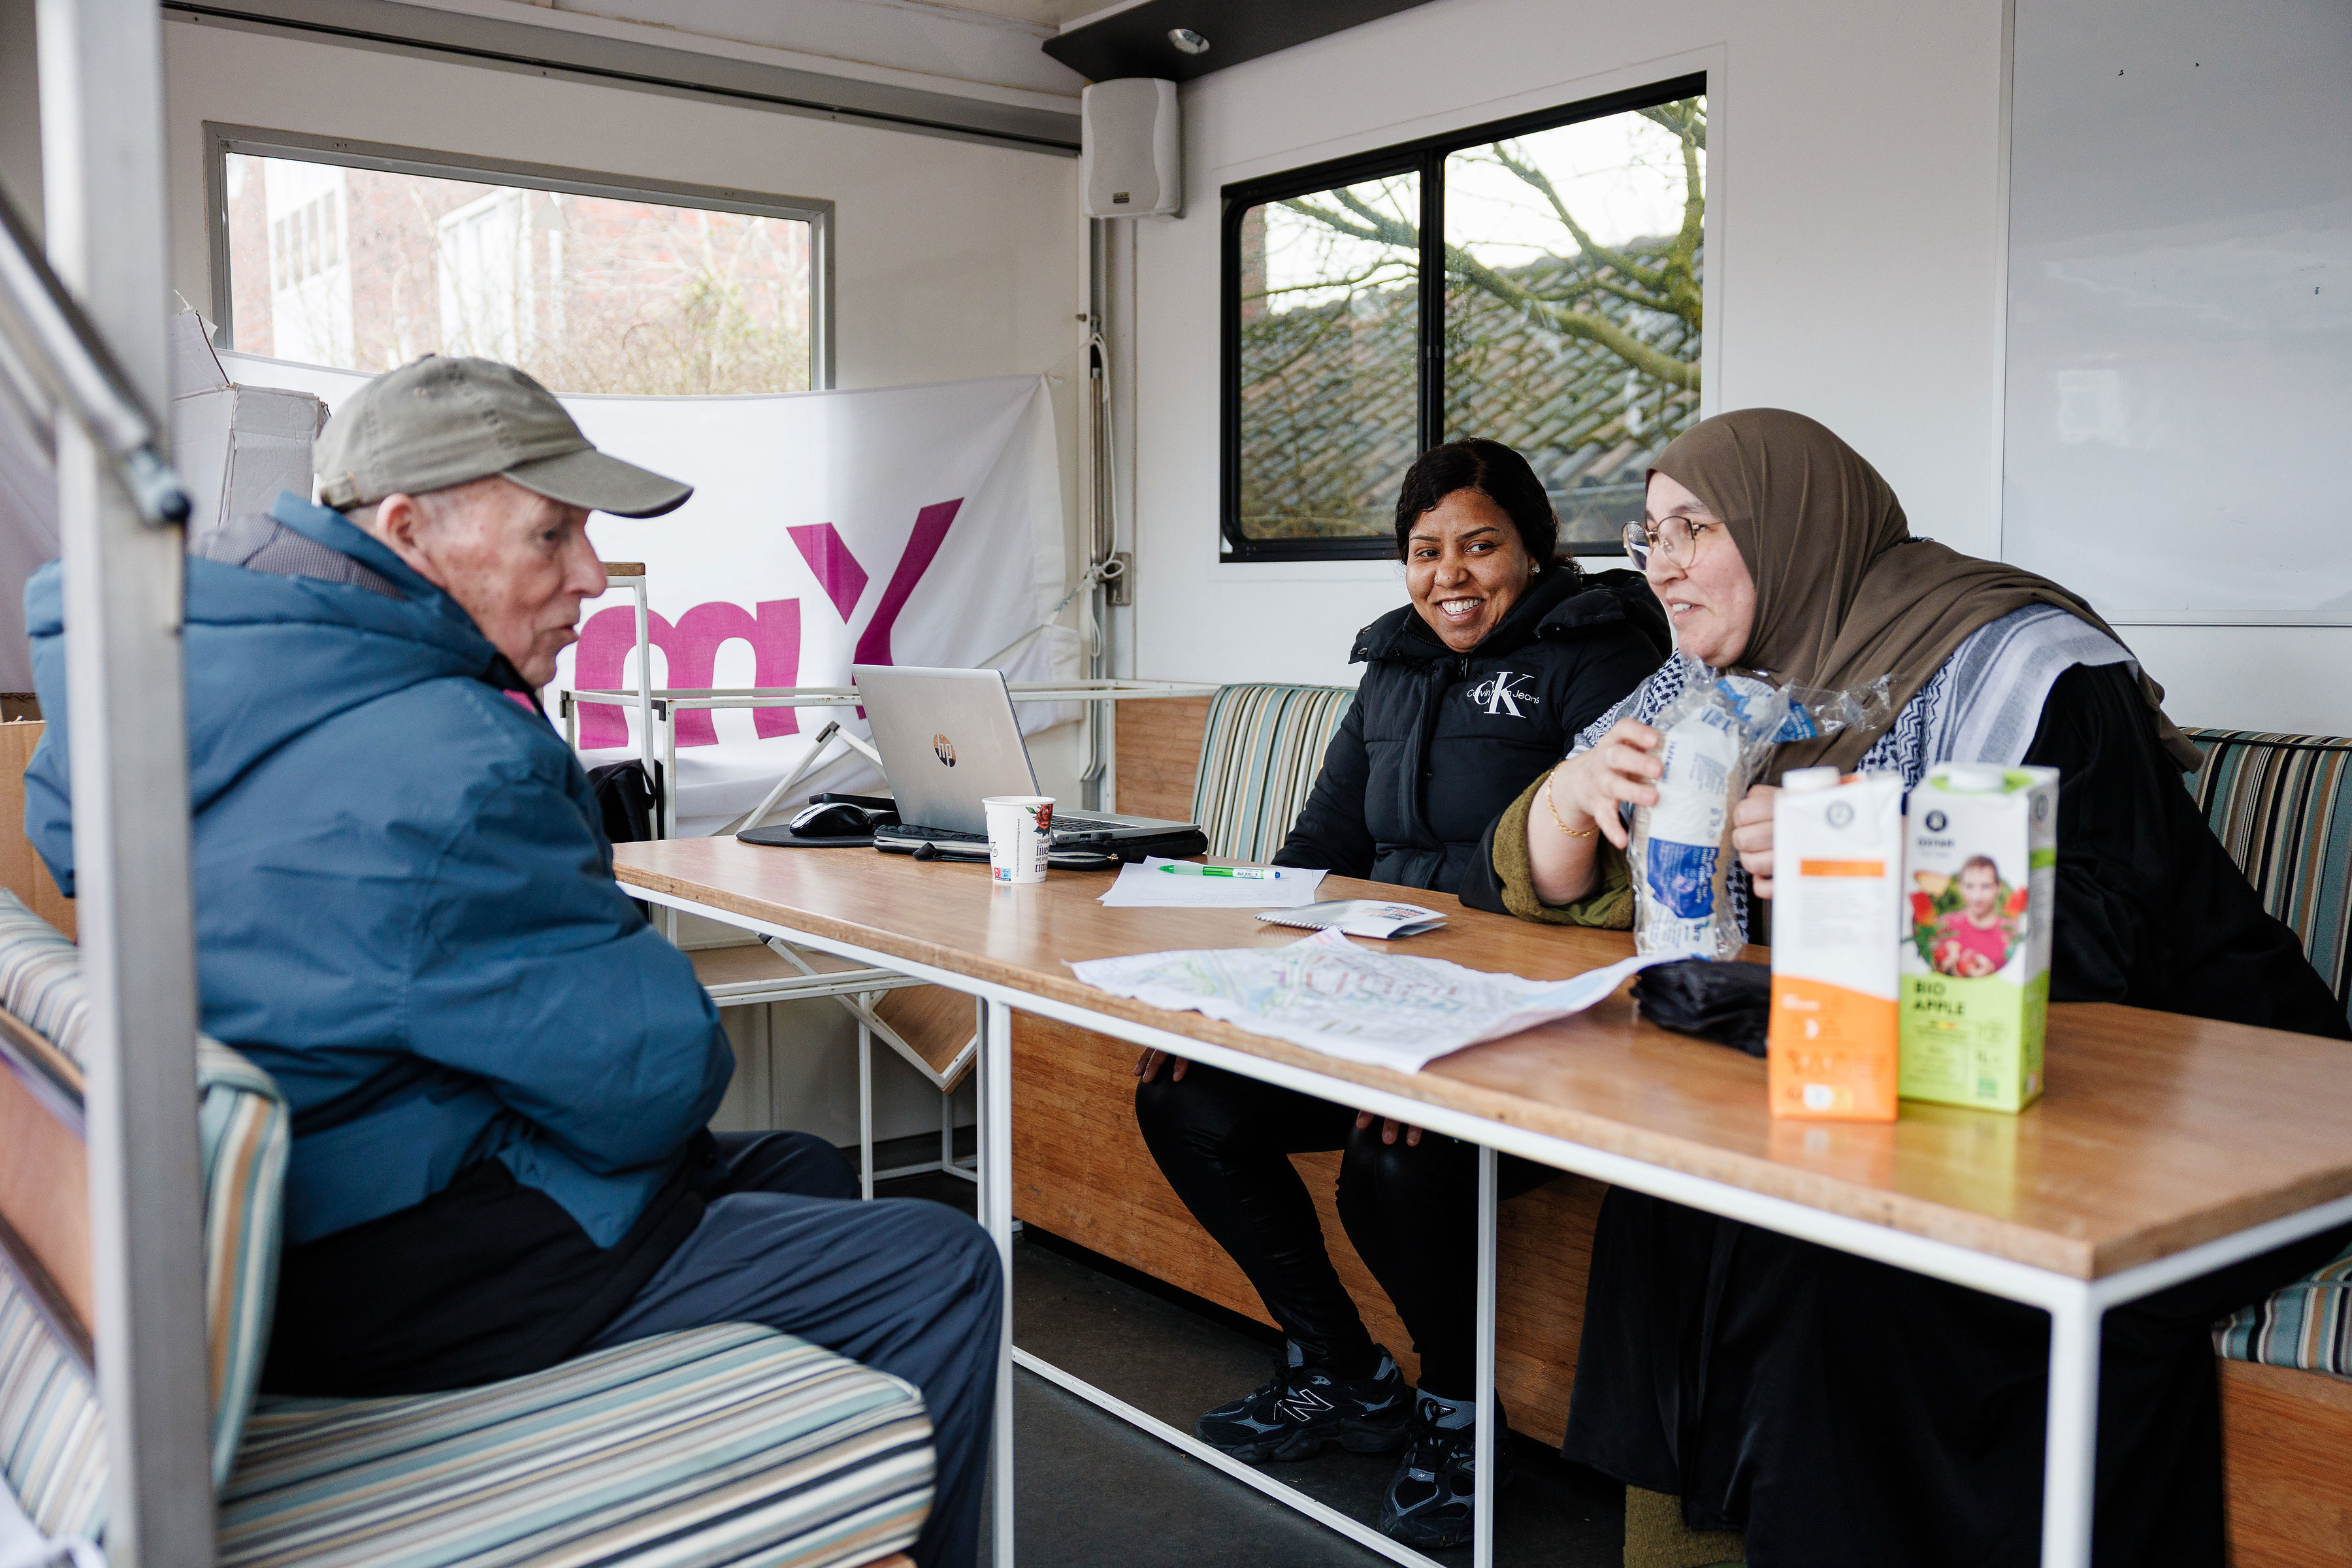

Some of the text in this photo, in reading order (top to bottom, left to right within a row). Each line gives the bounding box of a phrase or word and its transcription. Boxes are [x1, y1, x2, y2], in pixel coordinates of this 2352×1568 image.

[1512, 689, 1540, 704] Jeans
[936, 733, 954, 768] hp
[1915, 981, 1946, 995] BIO
[1914, 999, 1965, 1015] APPLE
